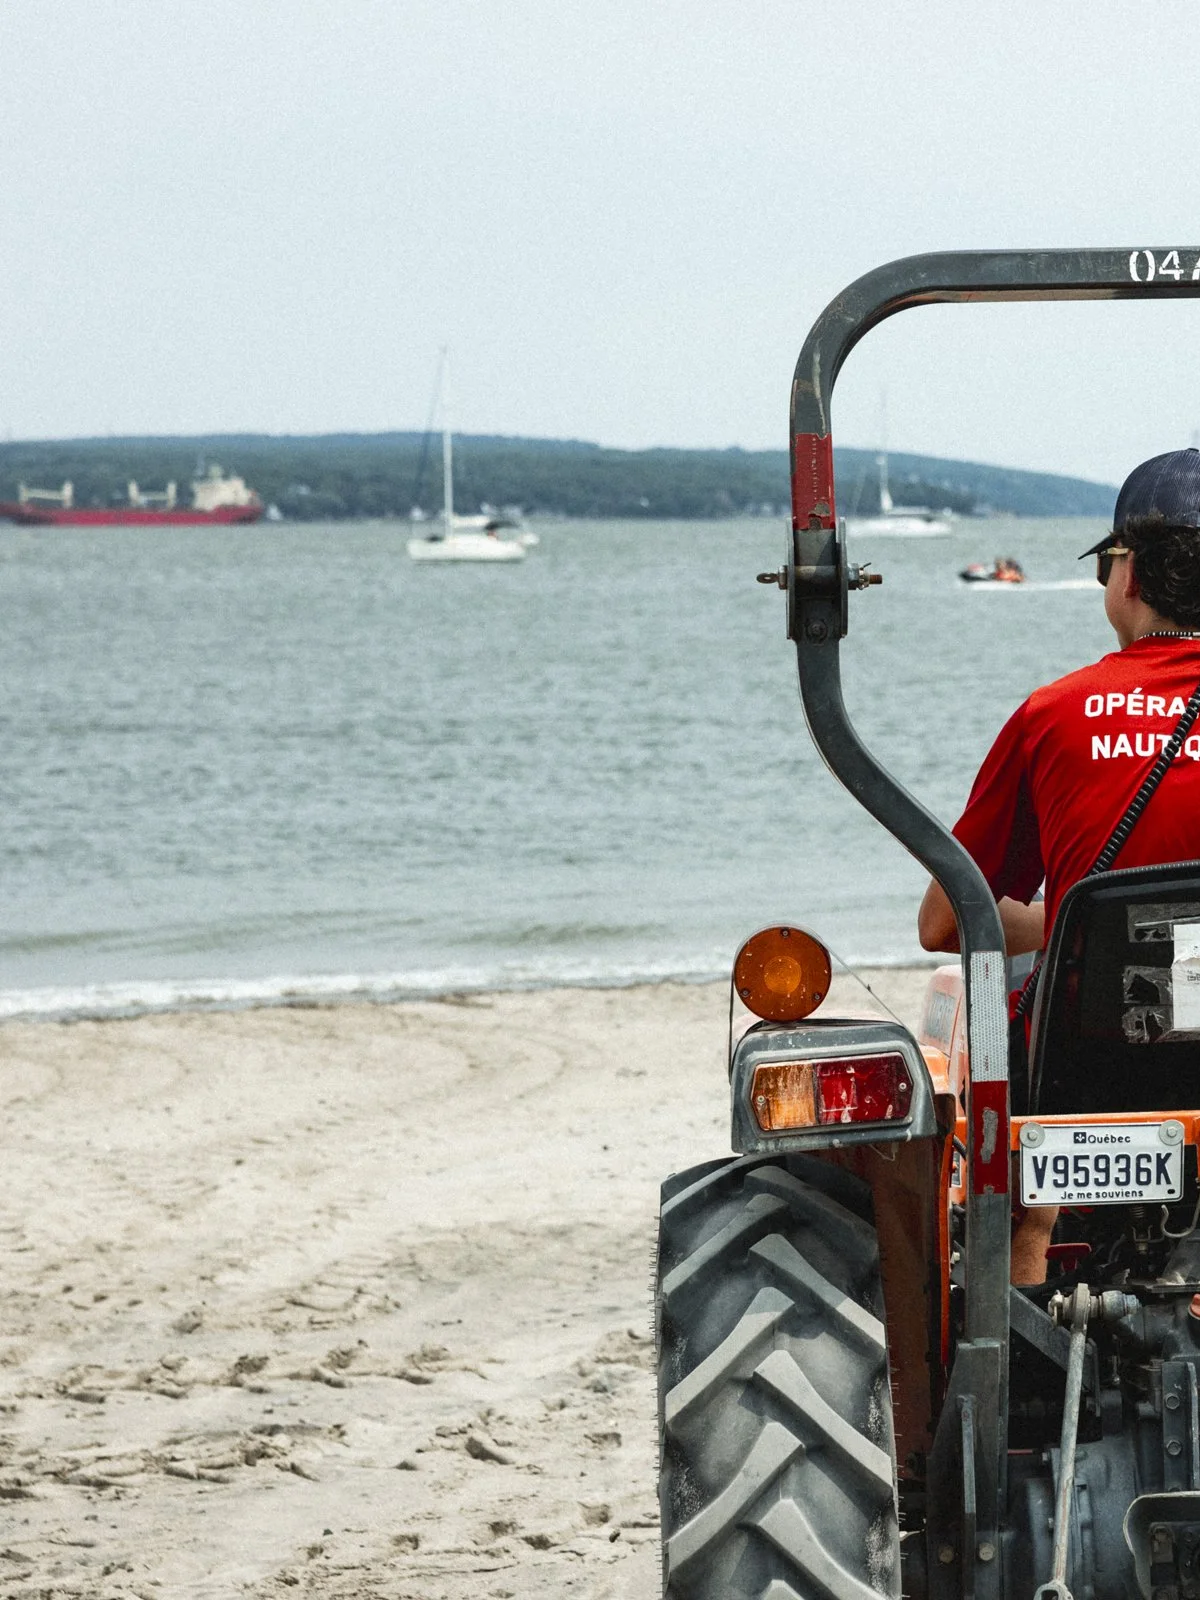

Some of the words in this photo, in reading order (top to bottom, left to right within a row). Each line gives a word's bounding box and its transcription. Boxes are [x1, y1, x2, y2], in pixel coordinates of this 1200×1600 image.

[1087, 1134, 1131, 1144] Québec
[1032, 1152, 1173, 1189] V95936K
[1061, 1190, 1074, 1200] Je
[1077, 1191, 1092, 1199] me
[1095, 1189, 1144, 1199] souviens
